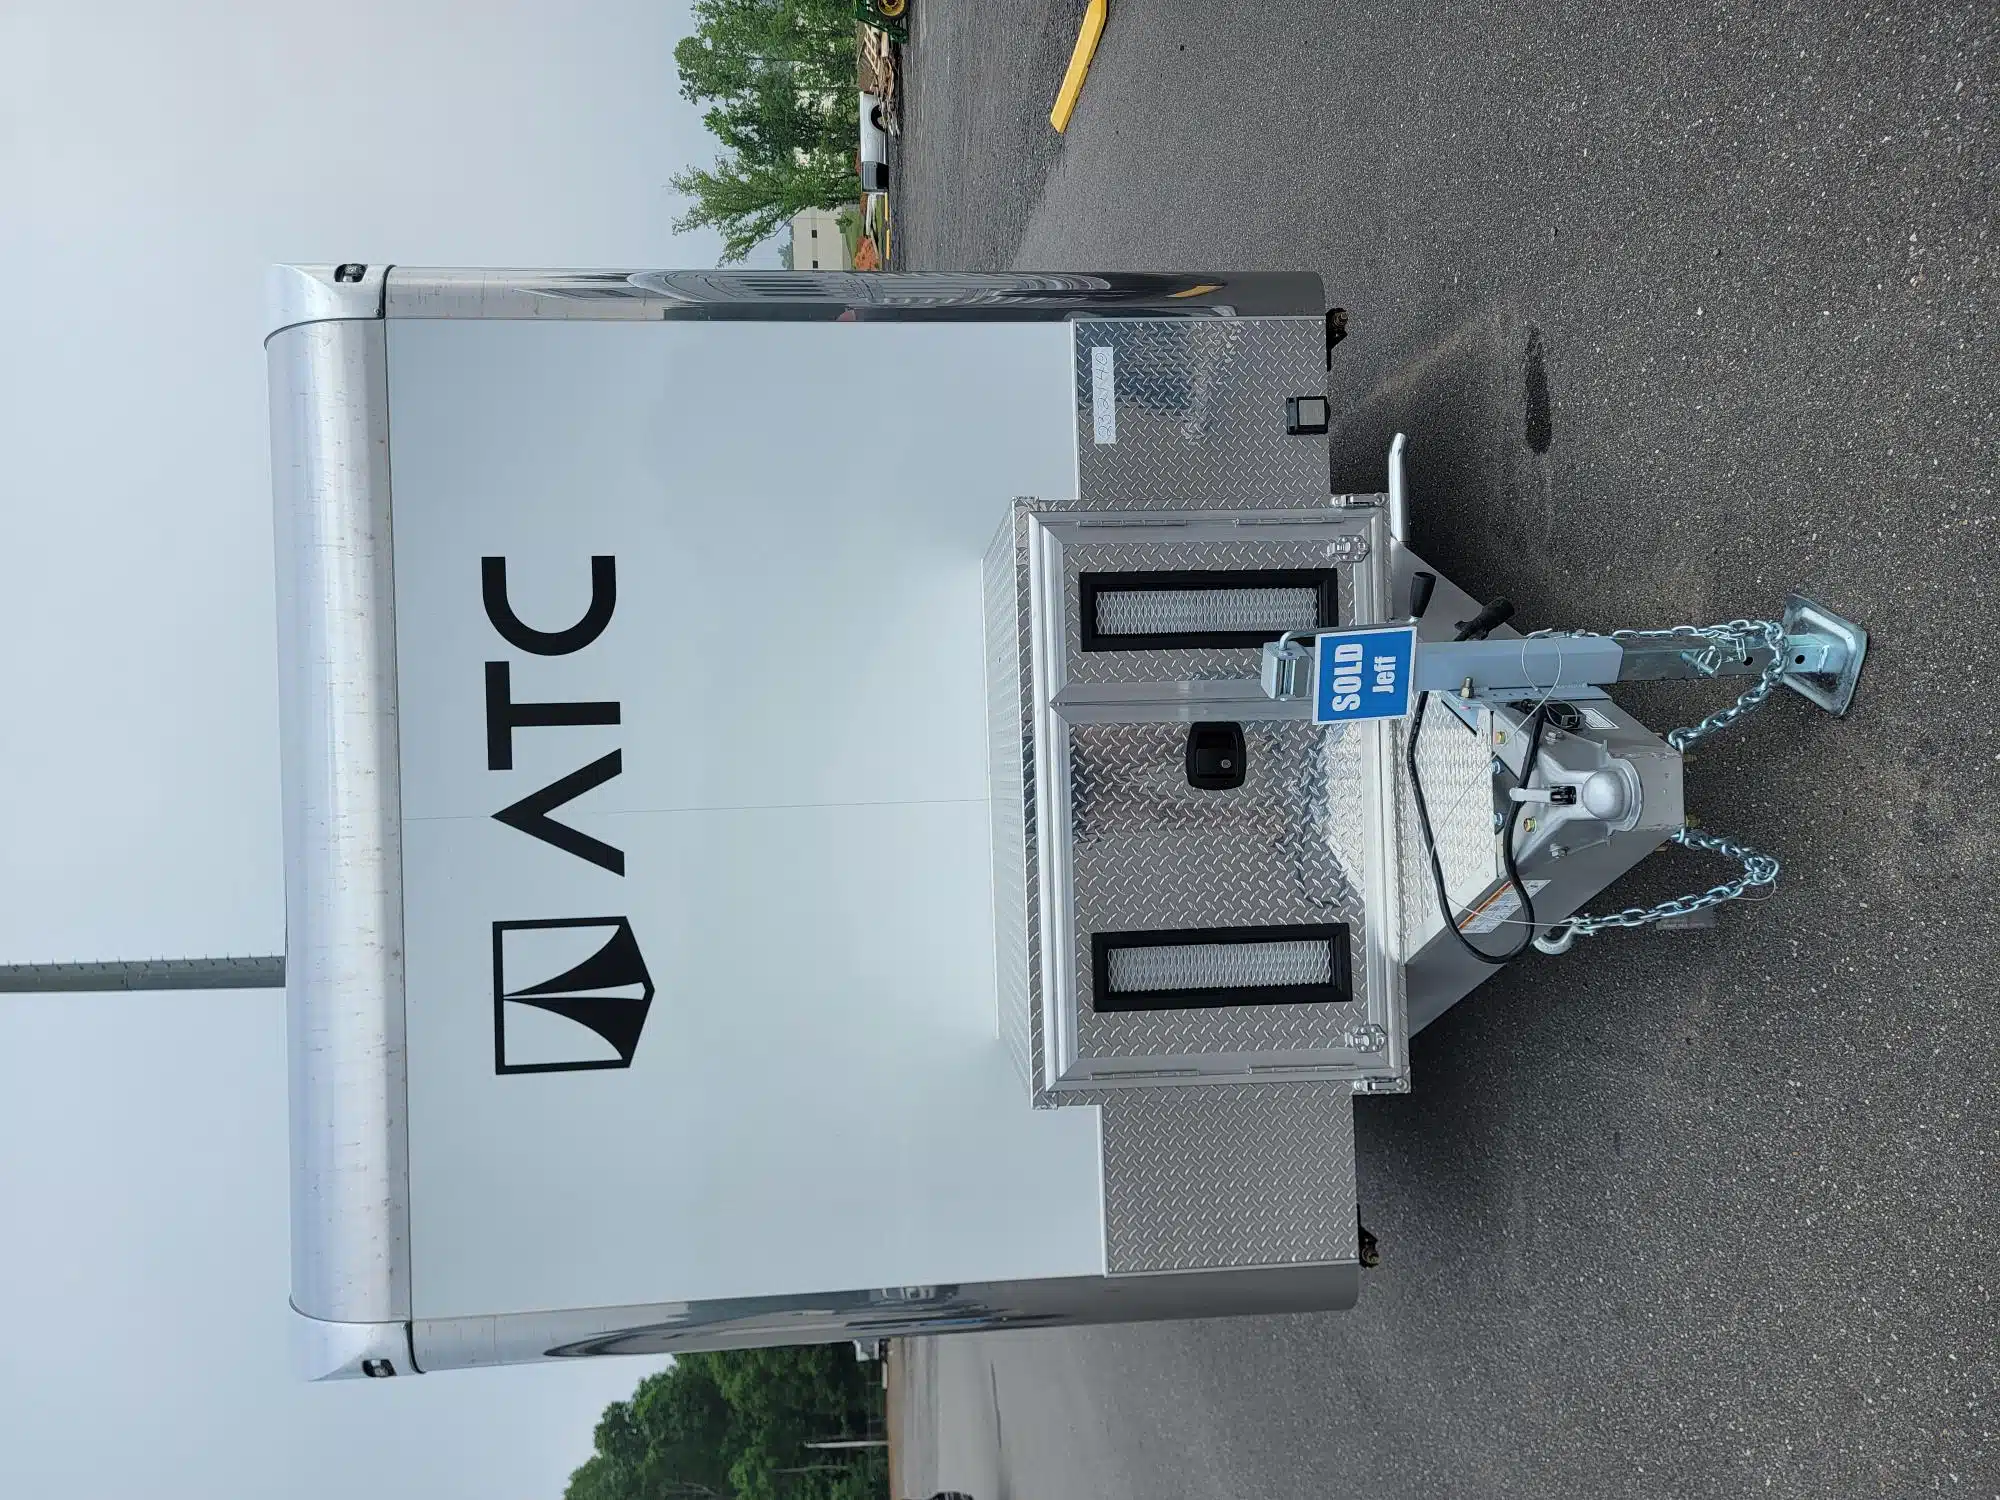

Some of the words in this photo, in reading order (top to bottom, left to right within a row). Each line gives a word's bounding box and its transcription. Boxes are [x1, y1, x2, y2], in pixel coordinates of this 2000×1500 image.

[1332, 643, 1364, 712] SOLD
[1372, 655, 1397, 694] Jeff
[481, 555, 625, 877] ATC
